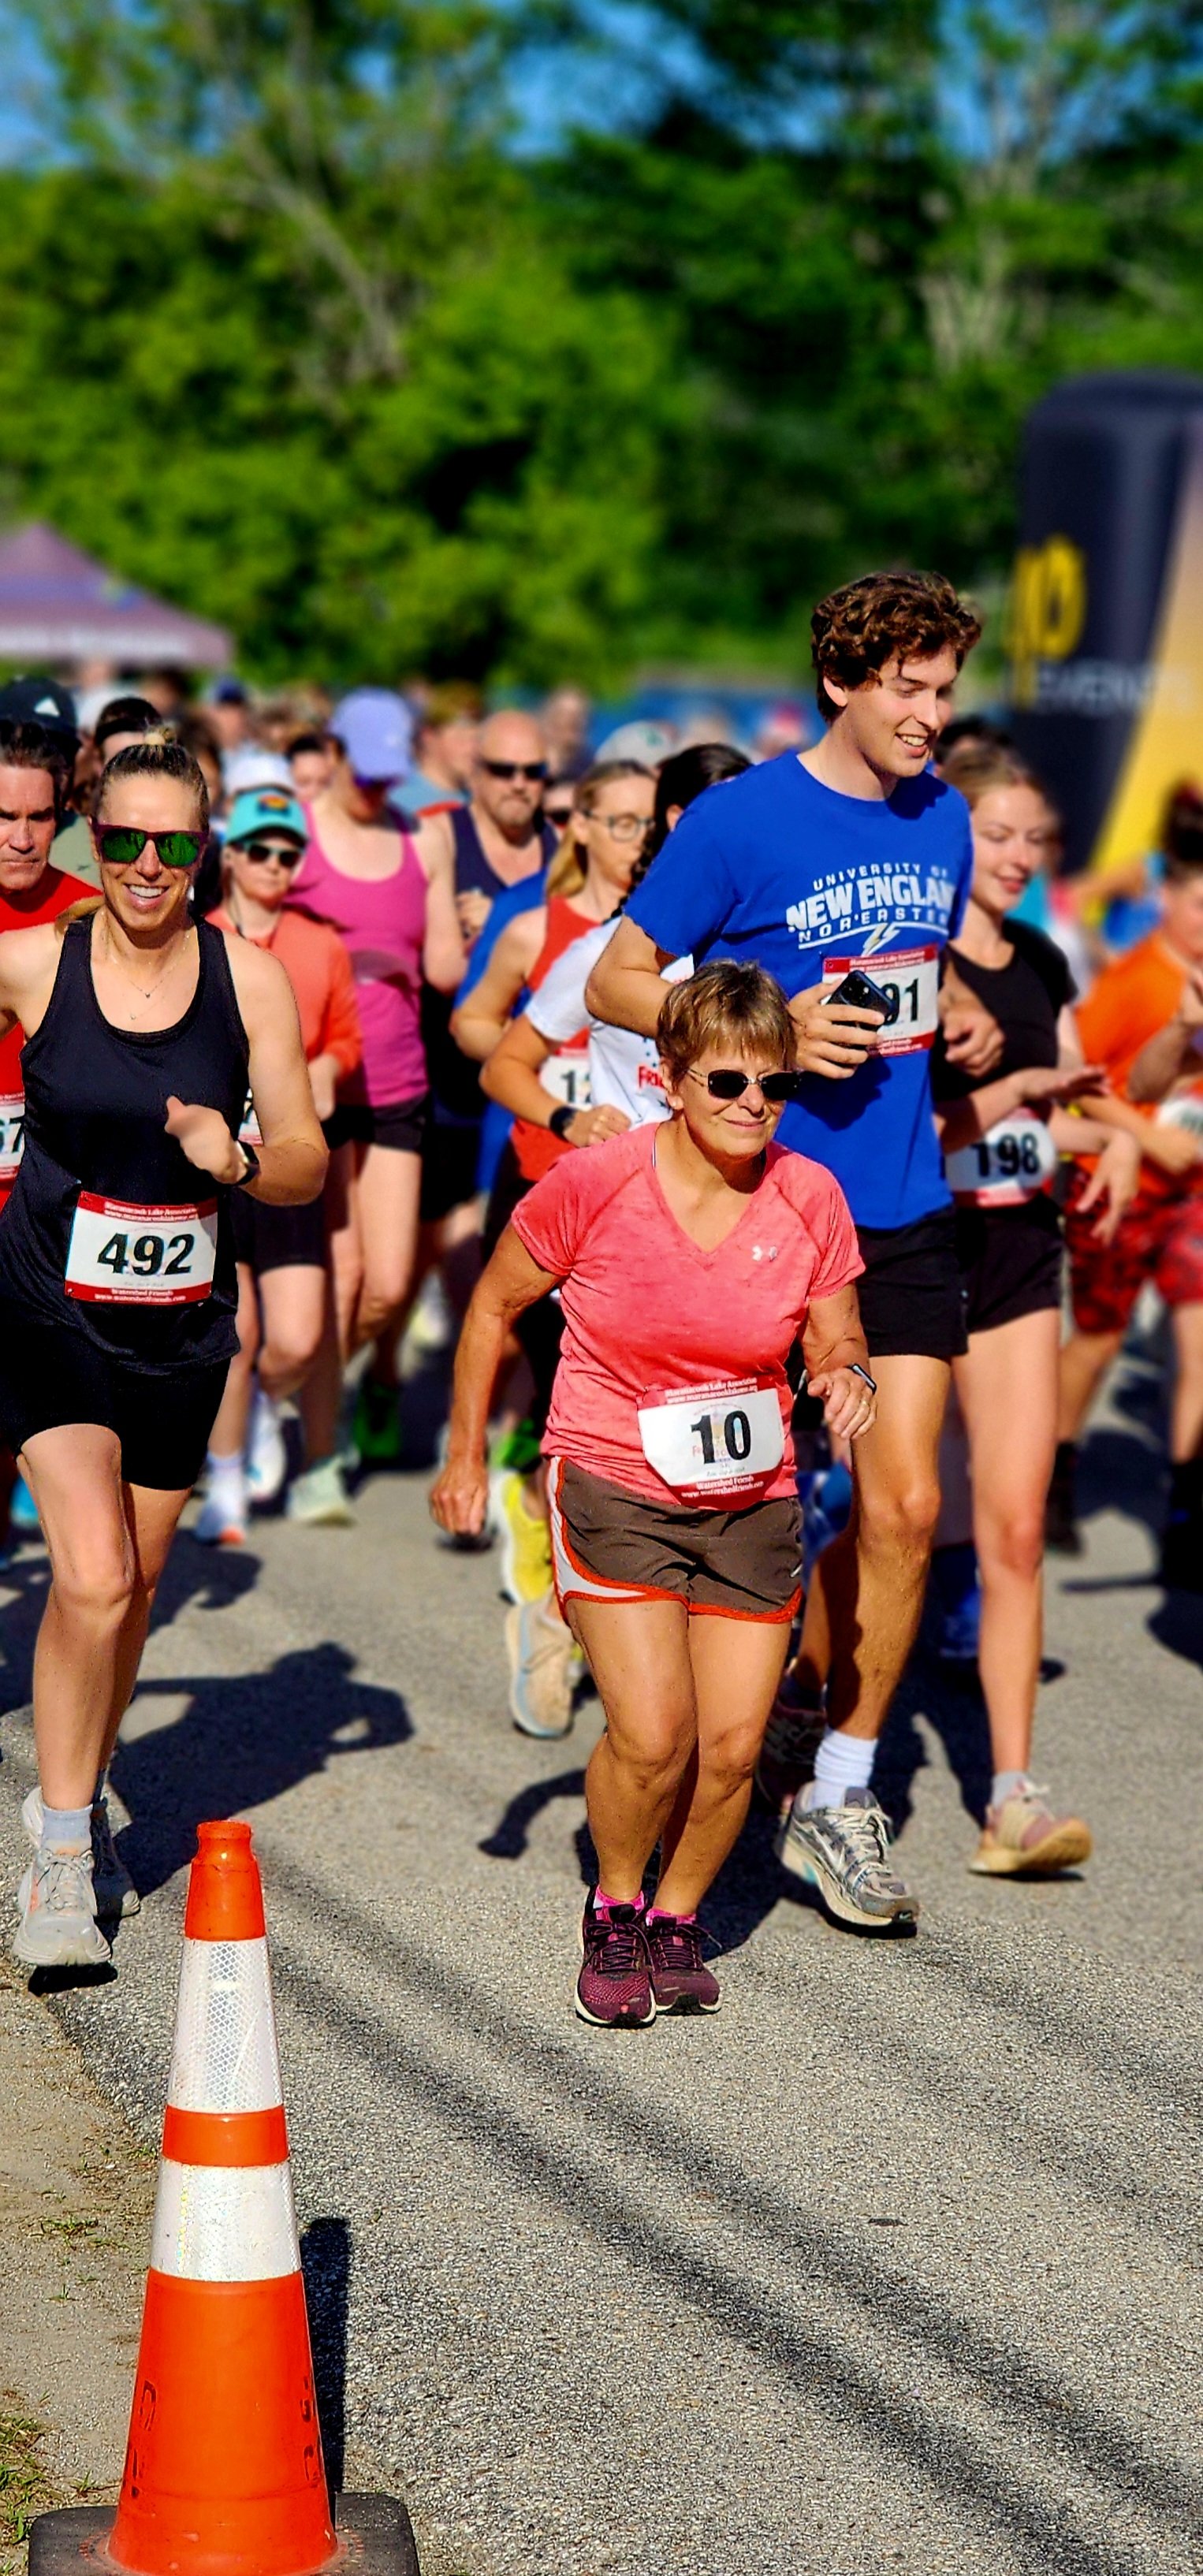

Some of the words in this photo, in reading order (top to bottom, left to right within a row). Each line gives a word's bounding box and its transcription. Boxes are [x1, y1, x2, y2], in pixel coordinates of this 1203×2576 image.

[813, 862, 921, 892] UNIVERSITY
[785, 882, 853, 932] NEW
[856, 875, 955, 910] ENGLAN
[881, 977, 919, 1026] 91
[971, 1133, 1040, 1177] 198
[97, 1232, 196, 1276] 492
[691, 1410, 751, 1464] 10
[696, 1477, 734, 1491] Watershed
